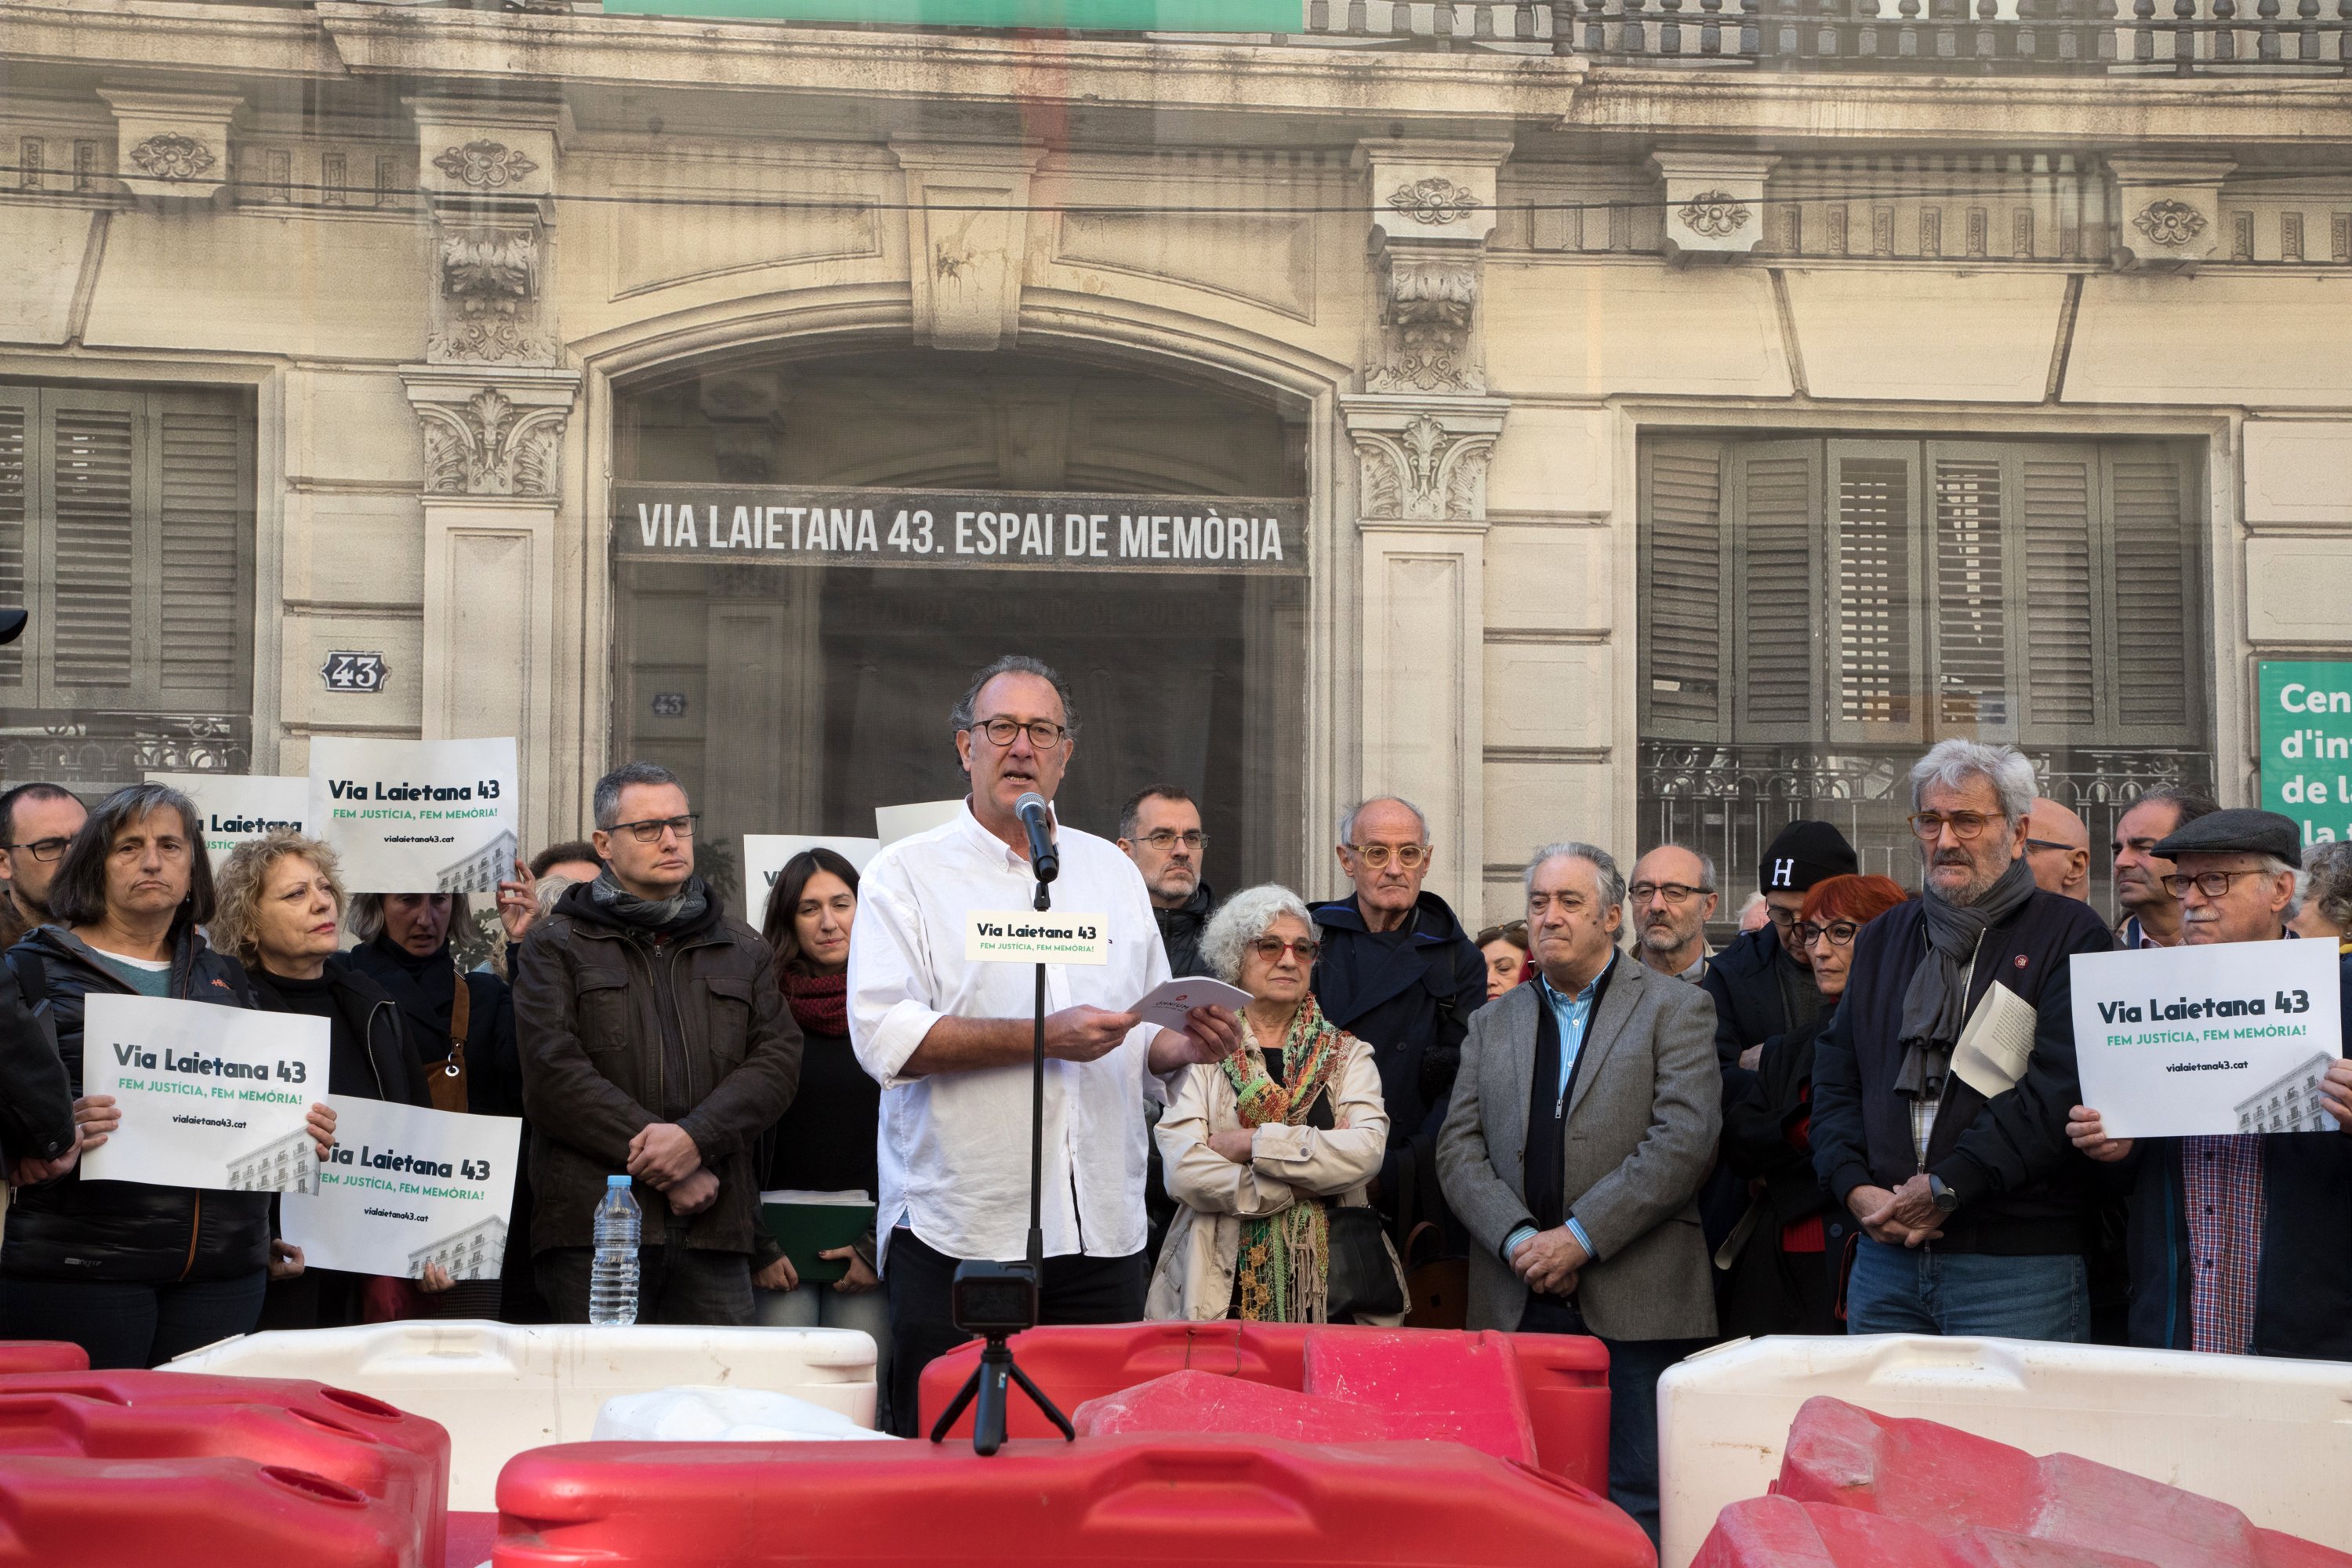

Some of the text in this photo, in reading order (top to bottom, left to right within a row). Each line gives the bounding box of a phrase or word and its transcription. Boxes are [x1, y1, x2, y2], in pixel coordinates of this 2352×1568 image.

[638, 503, 1283, 561] VIA LAIETANA 43. ESPAI DE MEMÒRIA
[332, 656, 378, 687] 43
[655, 695, 682, 714] 43
[2280, 683, 2351, 713] Cen
[2281, 729, 2352, 758] d'in
[328, 779, 500, 801] Via Laietana 43
[2281, 775, 2352, 804] de l
[333, 808, 498, 821] FEM JUSTÍCIA, FEM MEMÒRIA!
[2303, 820, 2336, 844] la
[1772, 858, 1794, 886] H
[977, 923, 1097, 939] Via Laietana 43
[998, 942, 1035, 951] JUSTÍCIA,
[2097, 989, 2310, 1024] Via Laietana 43
[2107, 1025, 2307, 1046] FEM JUSTÍCIA, FEM MEMÒRIA!
[113, 1043, 307, 1083] Via Laietana 43
[2166, 1061, 2249, 1073] vialaietana43.cat
[118, 1078, 303, 1105] FEM JUSTÍCIA, FEM MEMÒRIA!
[172, 1115, 247, 1129] vialaietana43.cat
[331, 1142, 490, 1181] ia Laietana 43
[343, 1176, 396, 1193] JUSTÍCIA,
[399, 1182, 419, 1194] FEM
[423, 1185, 485, 1200] MEMÒRIA!
[364, 1207, 429, 1222] vialaietana43.cat
